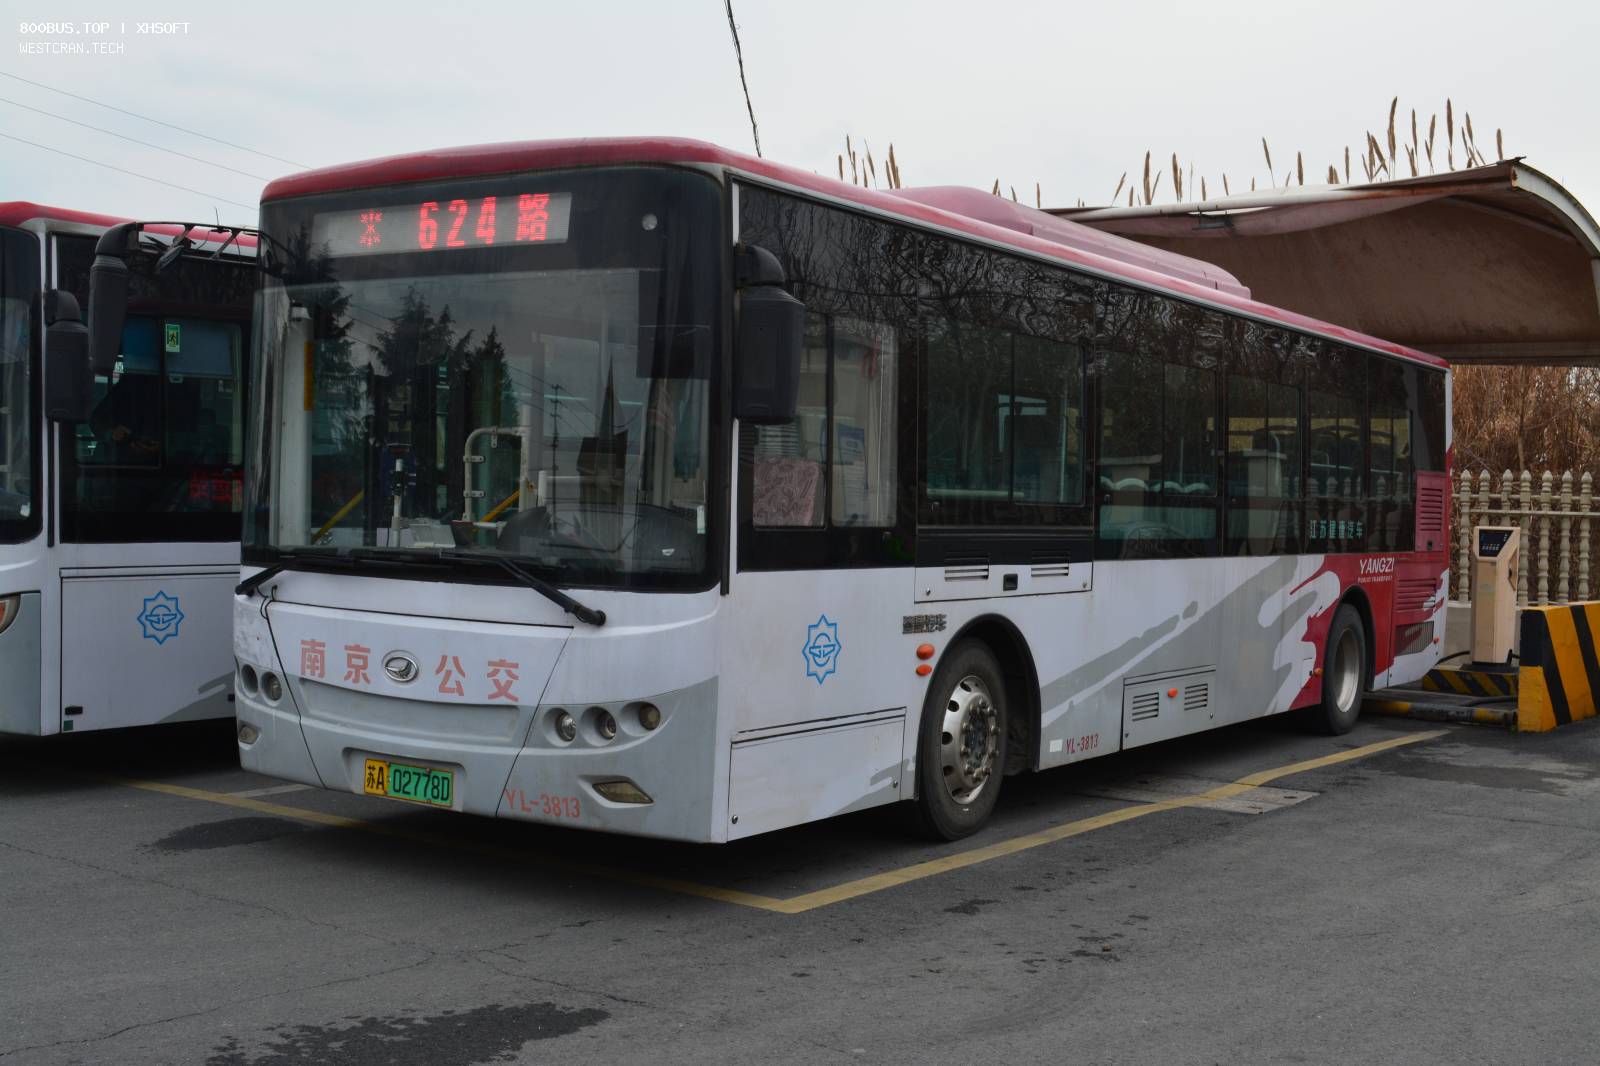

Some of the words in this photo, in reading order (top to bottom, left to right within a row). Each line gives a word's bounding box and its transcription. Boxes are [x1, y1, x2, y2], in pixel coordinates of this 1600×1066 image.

[1359, 557, 1395, 574] YANGZI
[1065, 733, 1099, 755] YL-3813
[505, 789, 581, 818] YL-3813
